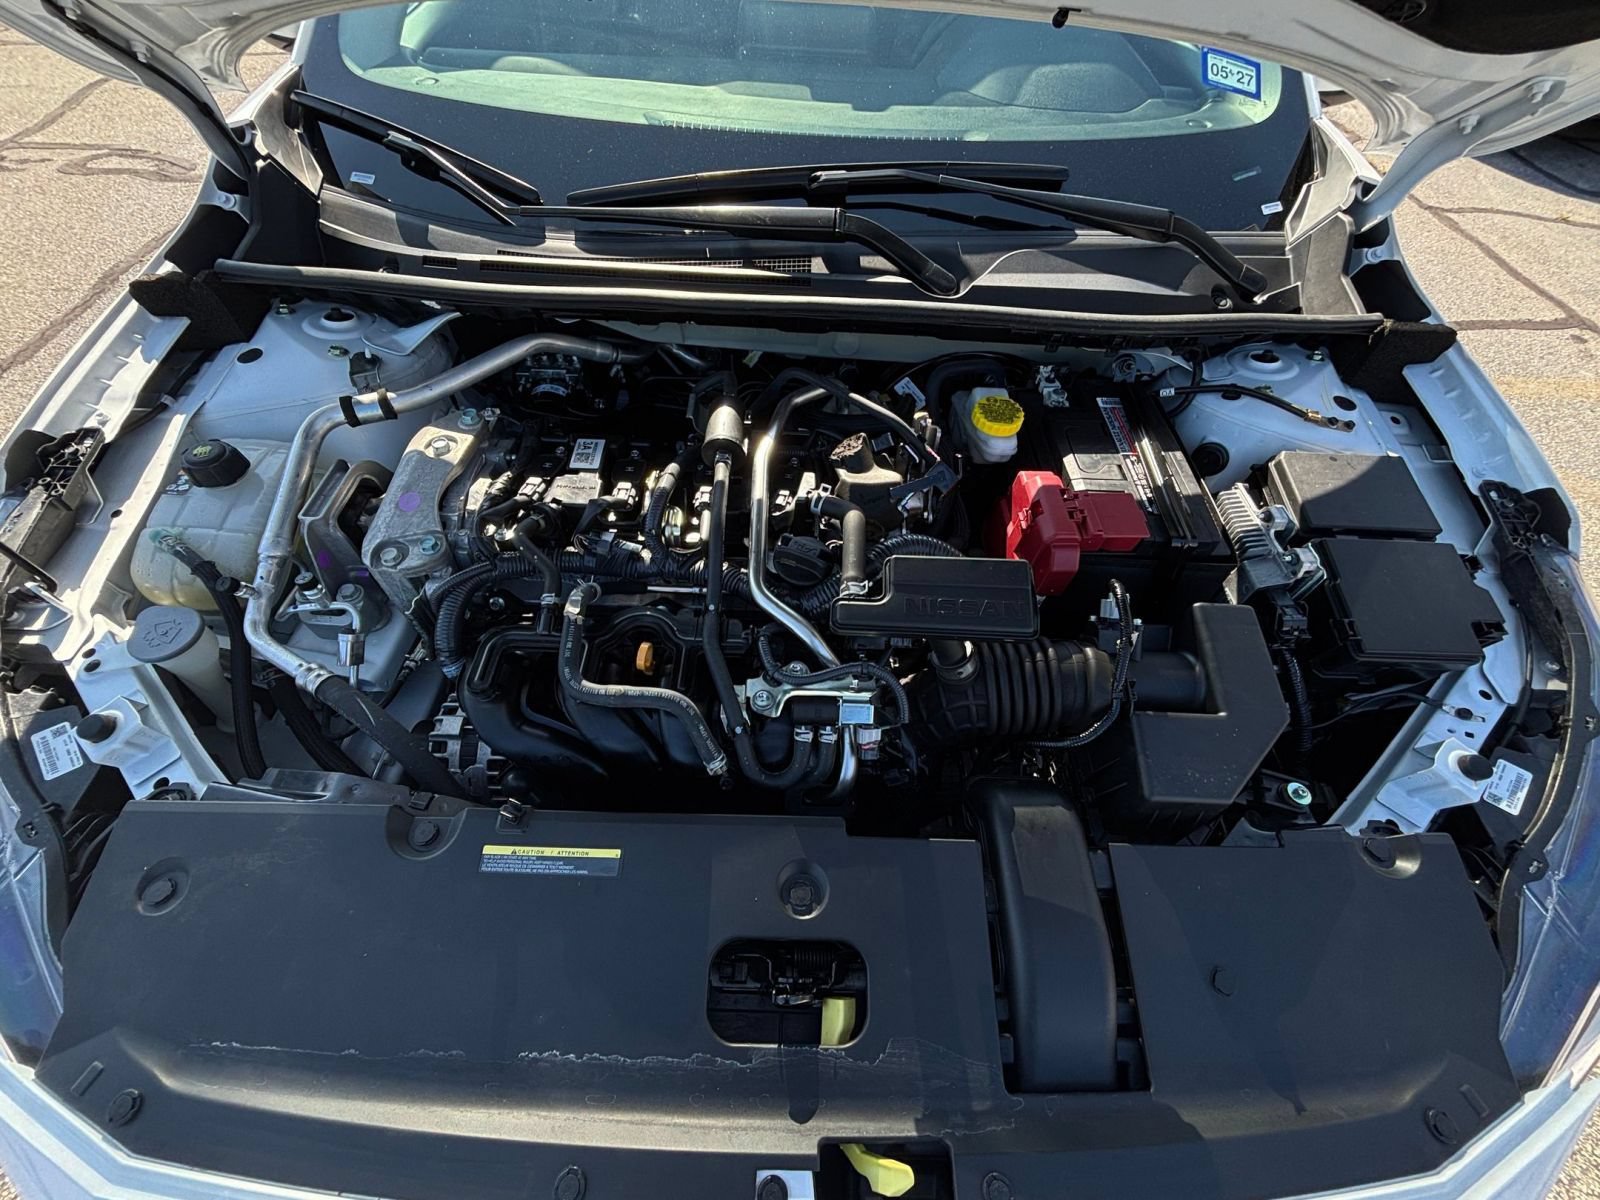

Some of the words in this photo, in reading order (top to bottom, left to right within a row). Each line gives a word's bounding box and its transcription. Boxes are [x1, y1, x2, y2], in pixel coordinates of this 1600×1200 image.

[1210, 63, 1229, 79] 05
[1236, 70, 1255, 87] 27
[903, 597, 1027, 617] NISSAN
